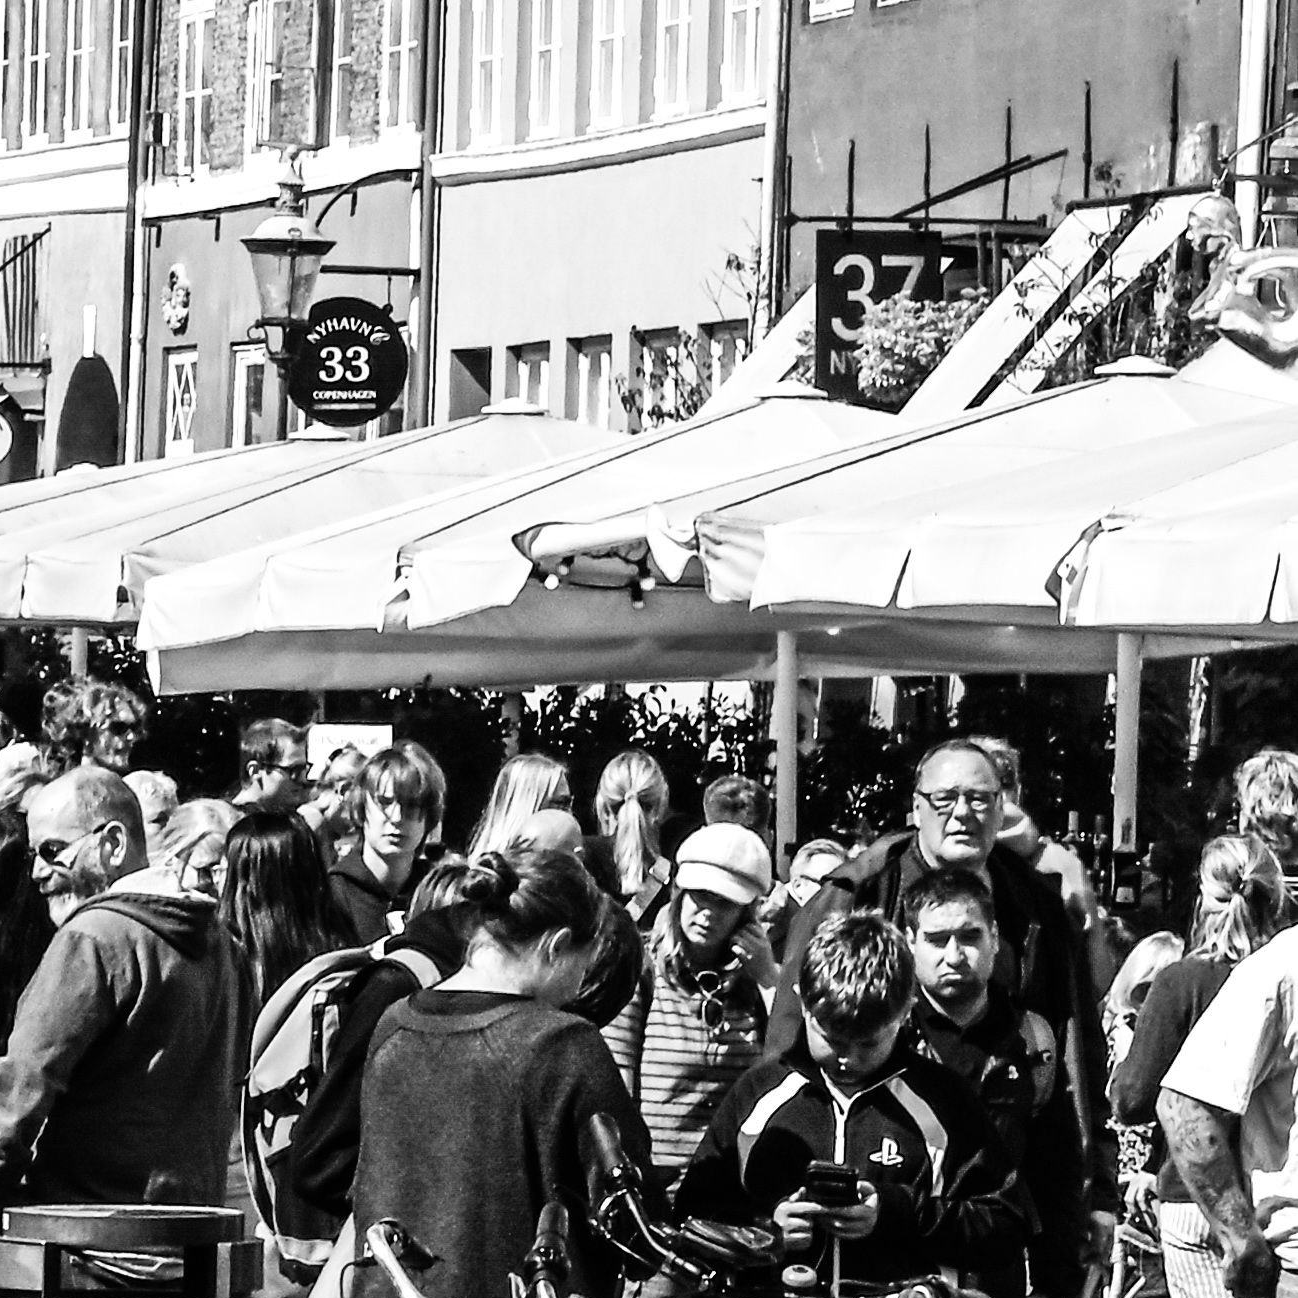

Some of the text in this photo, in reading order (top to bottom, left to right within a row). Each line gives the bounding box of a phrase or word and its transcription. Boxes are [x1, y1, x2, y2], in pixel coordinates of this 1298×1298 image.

[831, 254, 925, 342] 37
[318, 346, 370, 383] 33
[312, 389, 377, 401] COPENHAGEN
